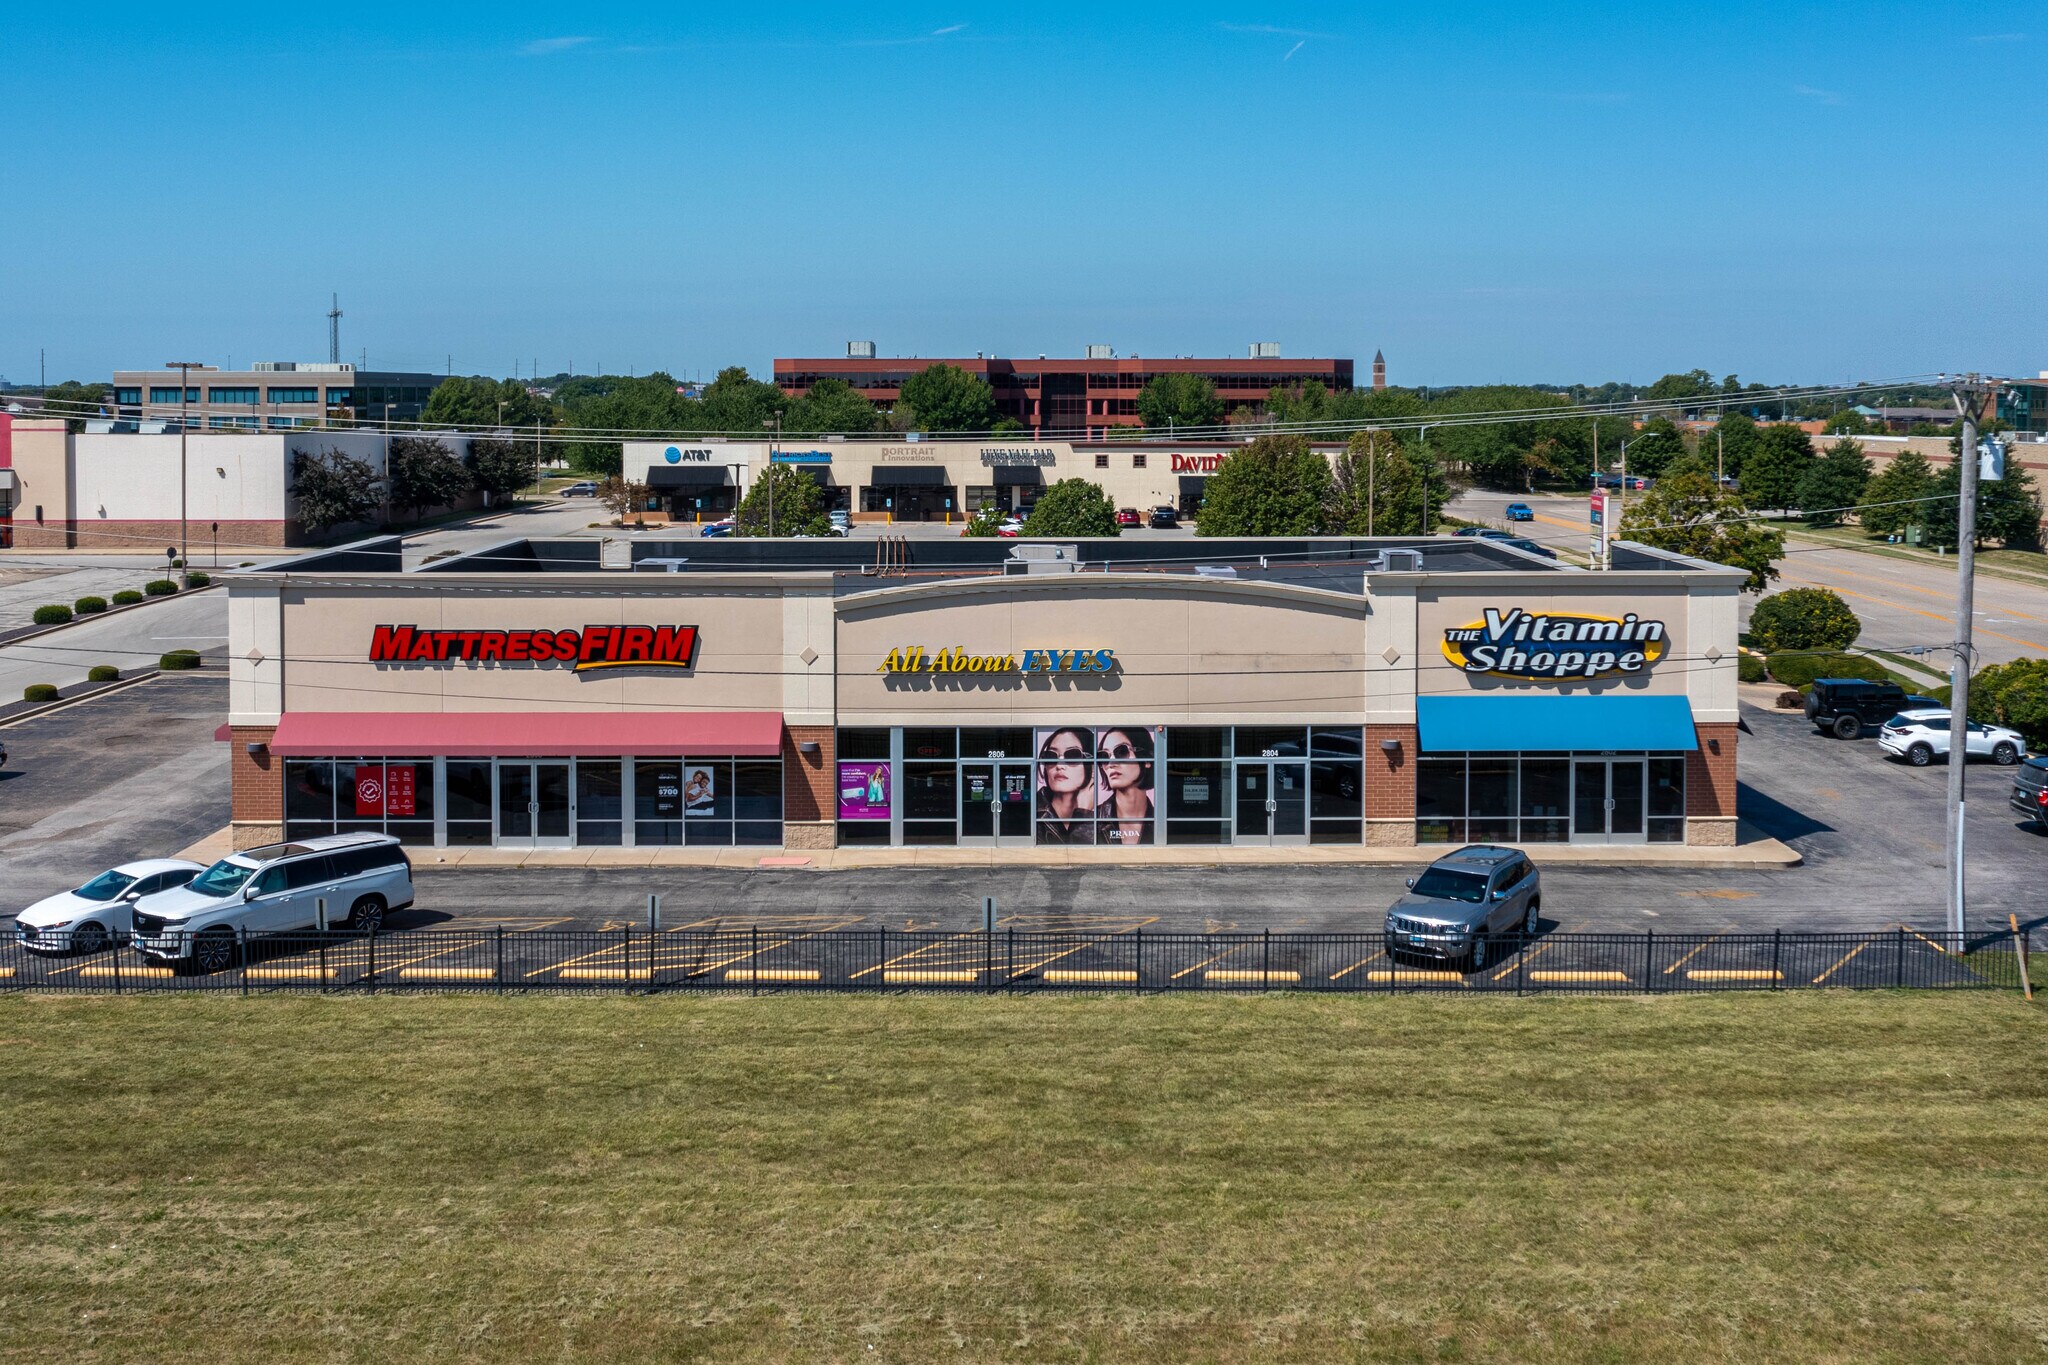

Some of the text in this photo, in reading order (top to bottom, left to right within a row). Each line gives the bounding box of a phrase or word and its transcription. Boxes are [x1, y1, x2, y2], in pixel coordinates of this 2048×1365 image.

[682, 449, 712, 462] AT&T
[881, 447, 935, 461] PORTRAIT
[1007, 449, 1030, 461] NAIL
[1033, 449, 1055, 461] BAR
[1446, 609, 1664, 642] THE Vitamin
[876, 645, 1115, 673] All About EYES
[1465, 645, 1646, 676] Shoppe
[988, 750, 1005, 758] 2806
[1262, 749, 1279, 757] 2804
